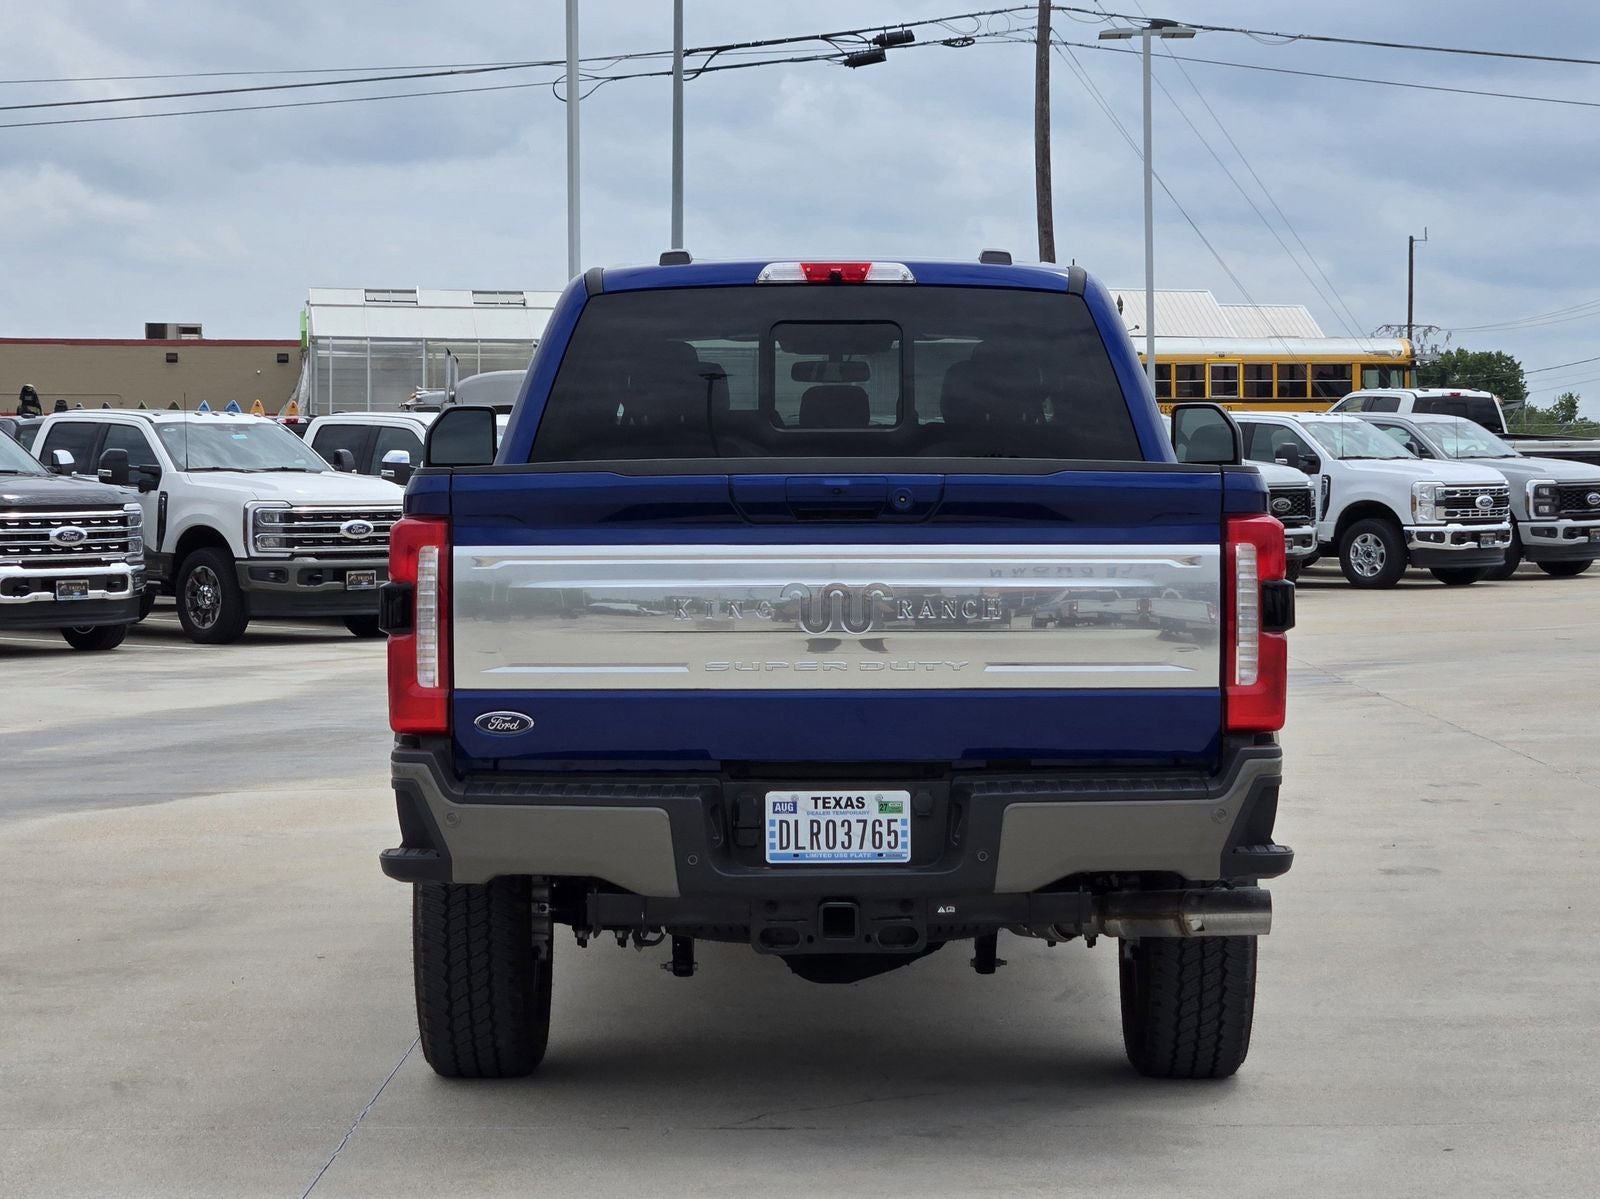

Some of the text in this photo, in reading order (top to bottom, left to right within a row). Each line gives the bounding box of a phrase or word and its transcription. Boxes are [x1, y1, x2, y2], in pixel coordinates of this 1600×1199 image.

[672, 598, 1002, 621] KING RANCH
[704, 660, 969, 672] SUPER DUTY
[487, 716, 520, 730] Ford
[775, 802, 794, 811] AUG
[811, 796, 866, 810] TEXAS
